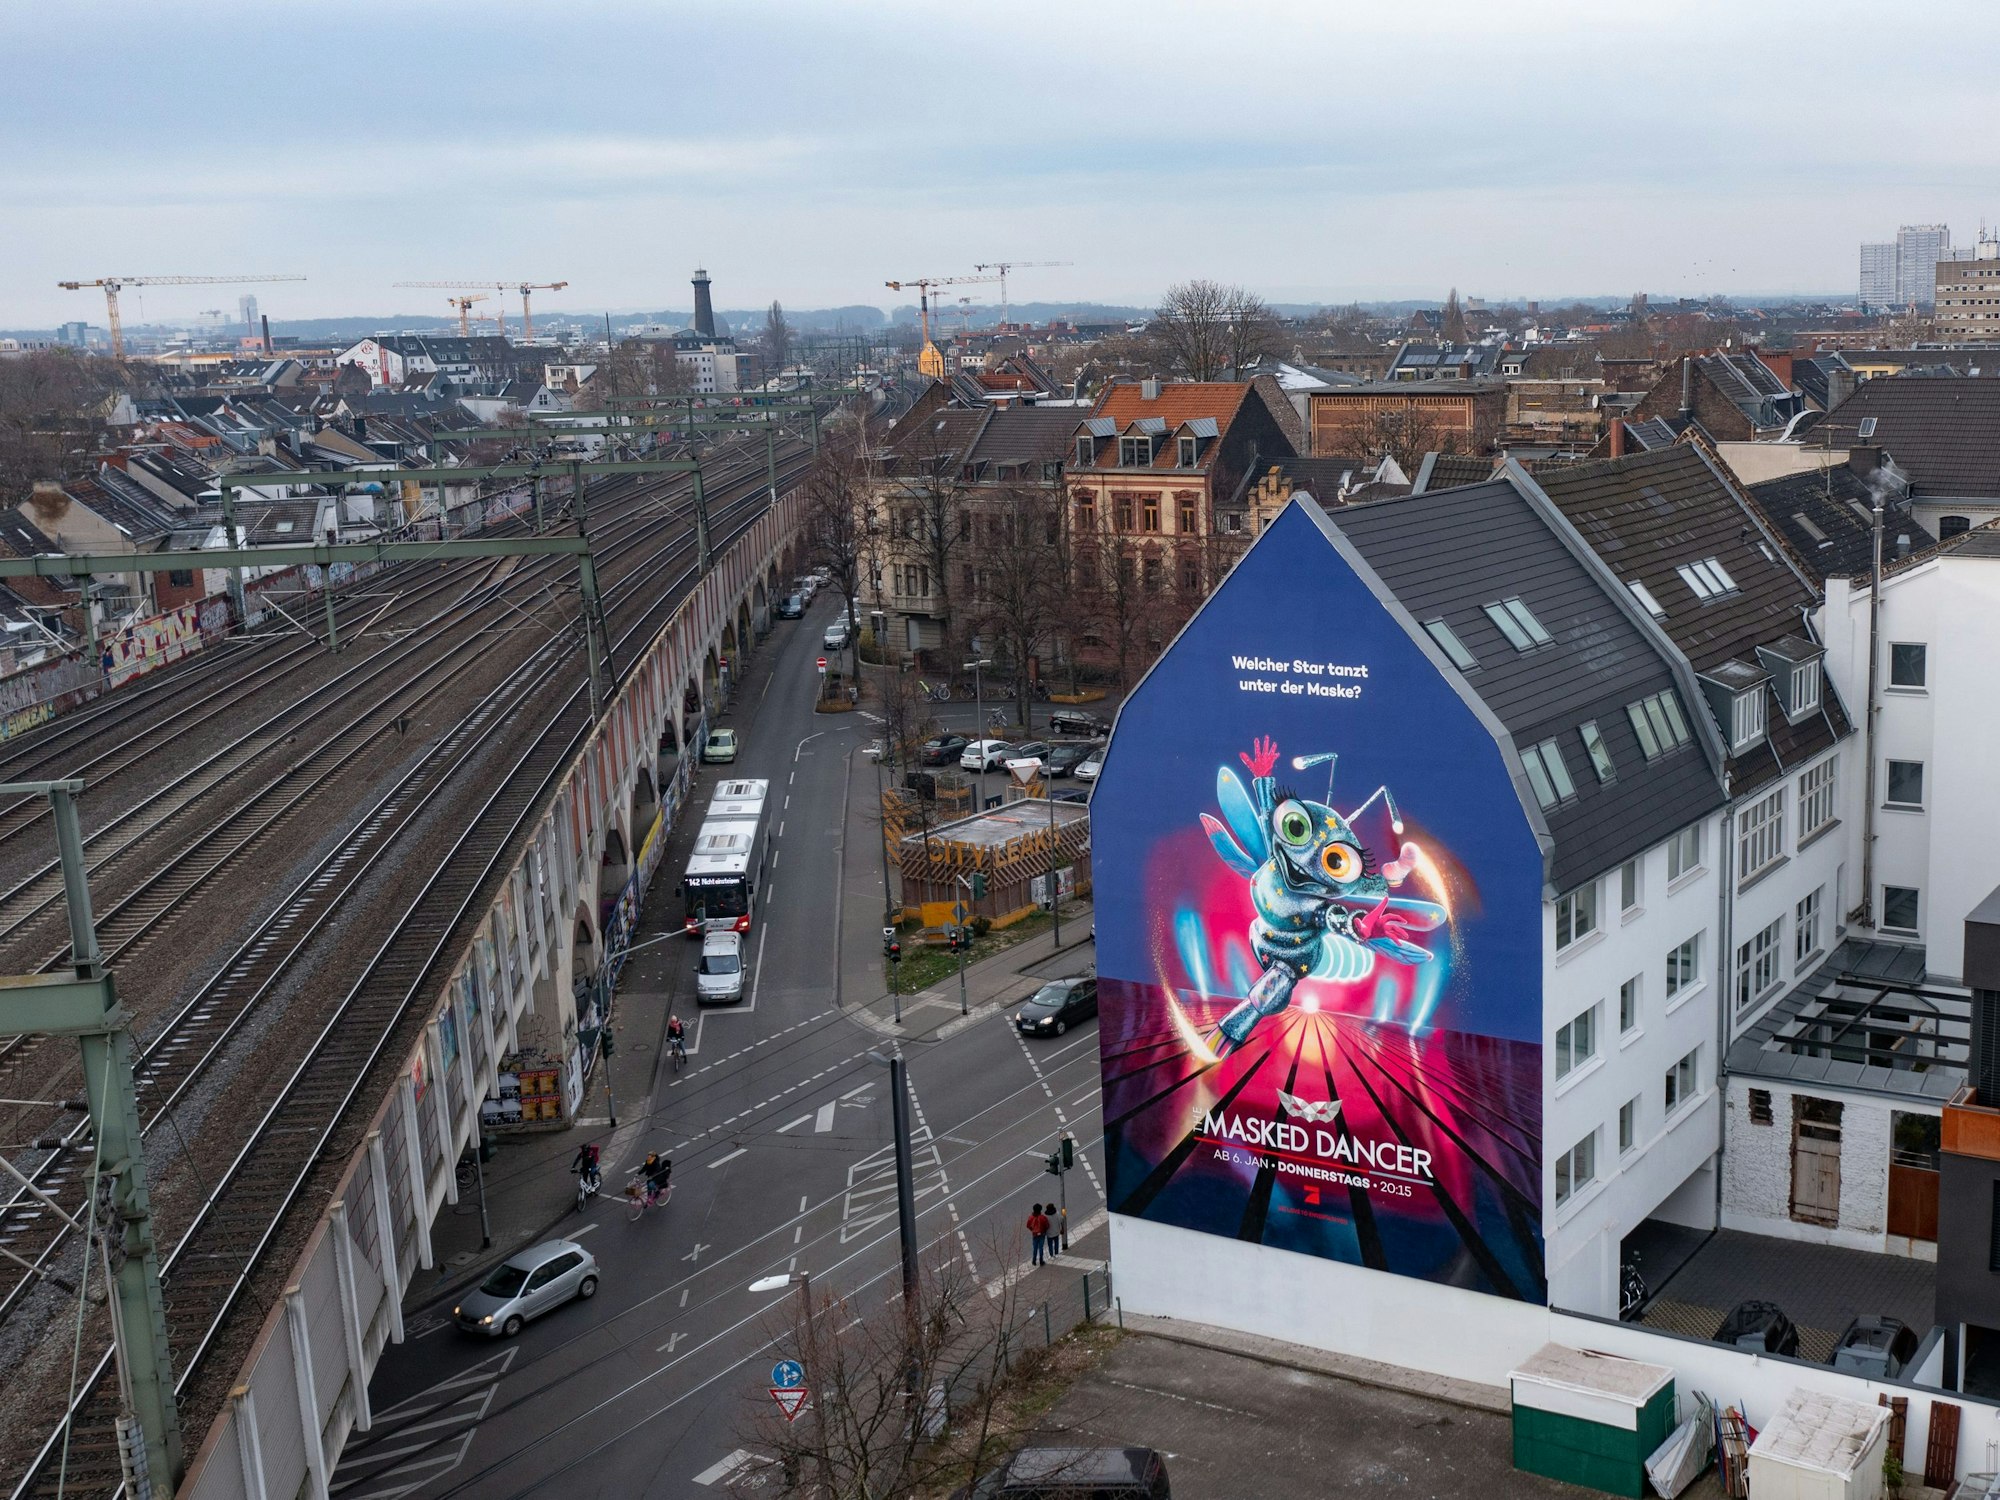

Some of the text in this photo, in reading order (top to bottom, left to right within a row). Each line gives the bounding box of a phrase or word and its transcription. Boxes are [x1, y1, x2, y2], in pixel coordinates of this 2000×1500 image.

[1232, 656, 1369, 678] Welcher Star tanzt
[1239, 679, 1362, 699] unter der Maske?
[927, 823, 1060, 870] CITY LEAKS
[688, 878, 701, 887] 142
[1193, 1106, 1203, 1132] THE
[1203, 1109, 1434, 1178] MASKED DANCER
[1213, 1149, 1412, 1197] AB 6. JAN DONNERSTAGS 20:15
